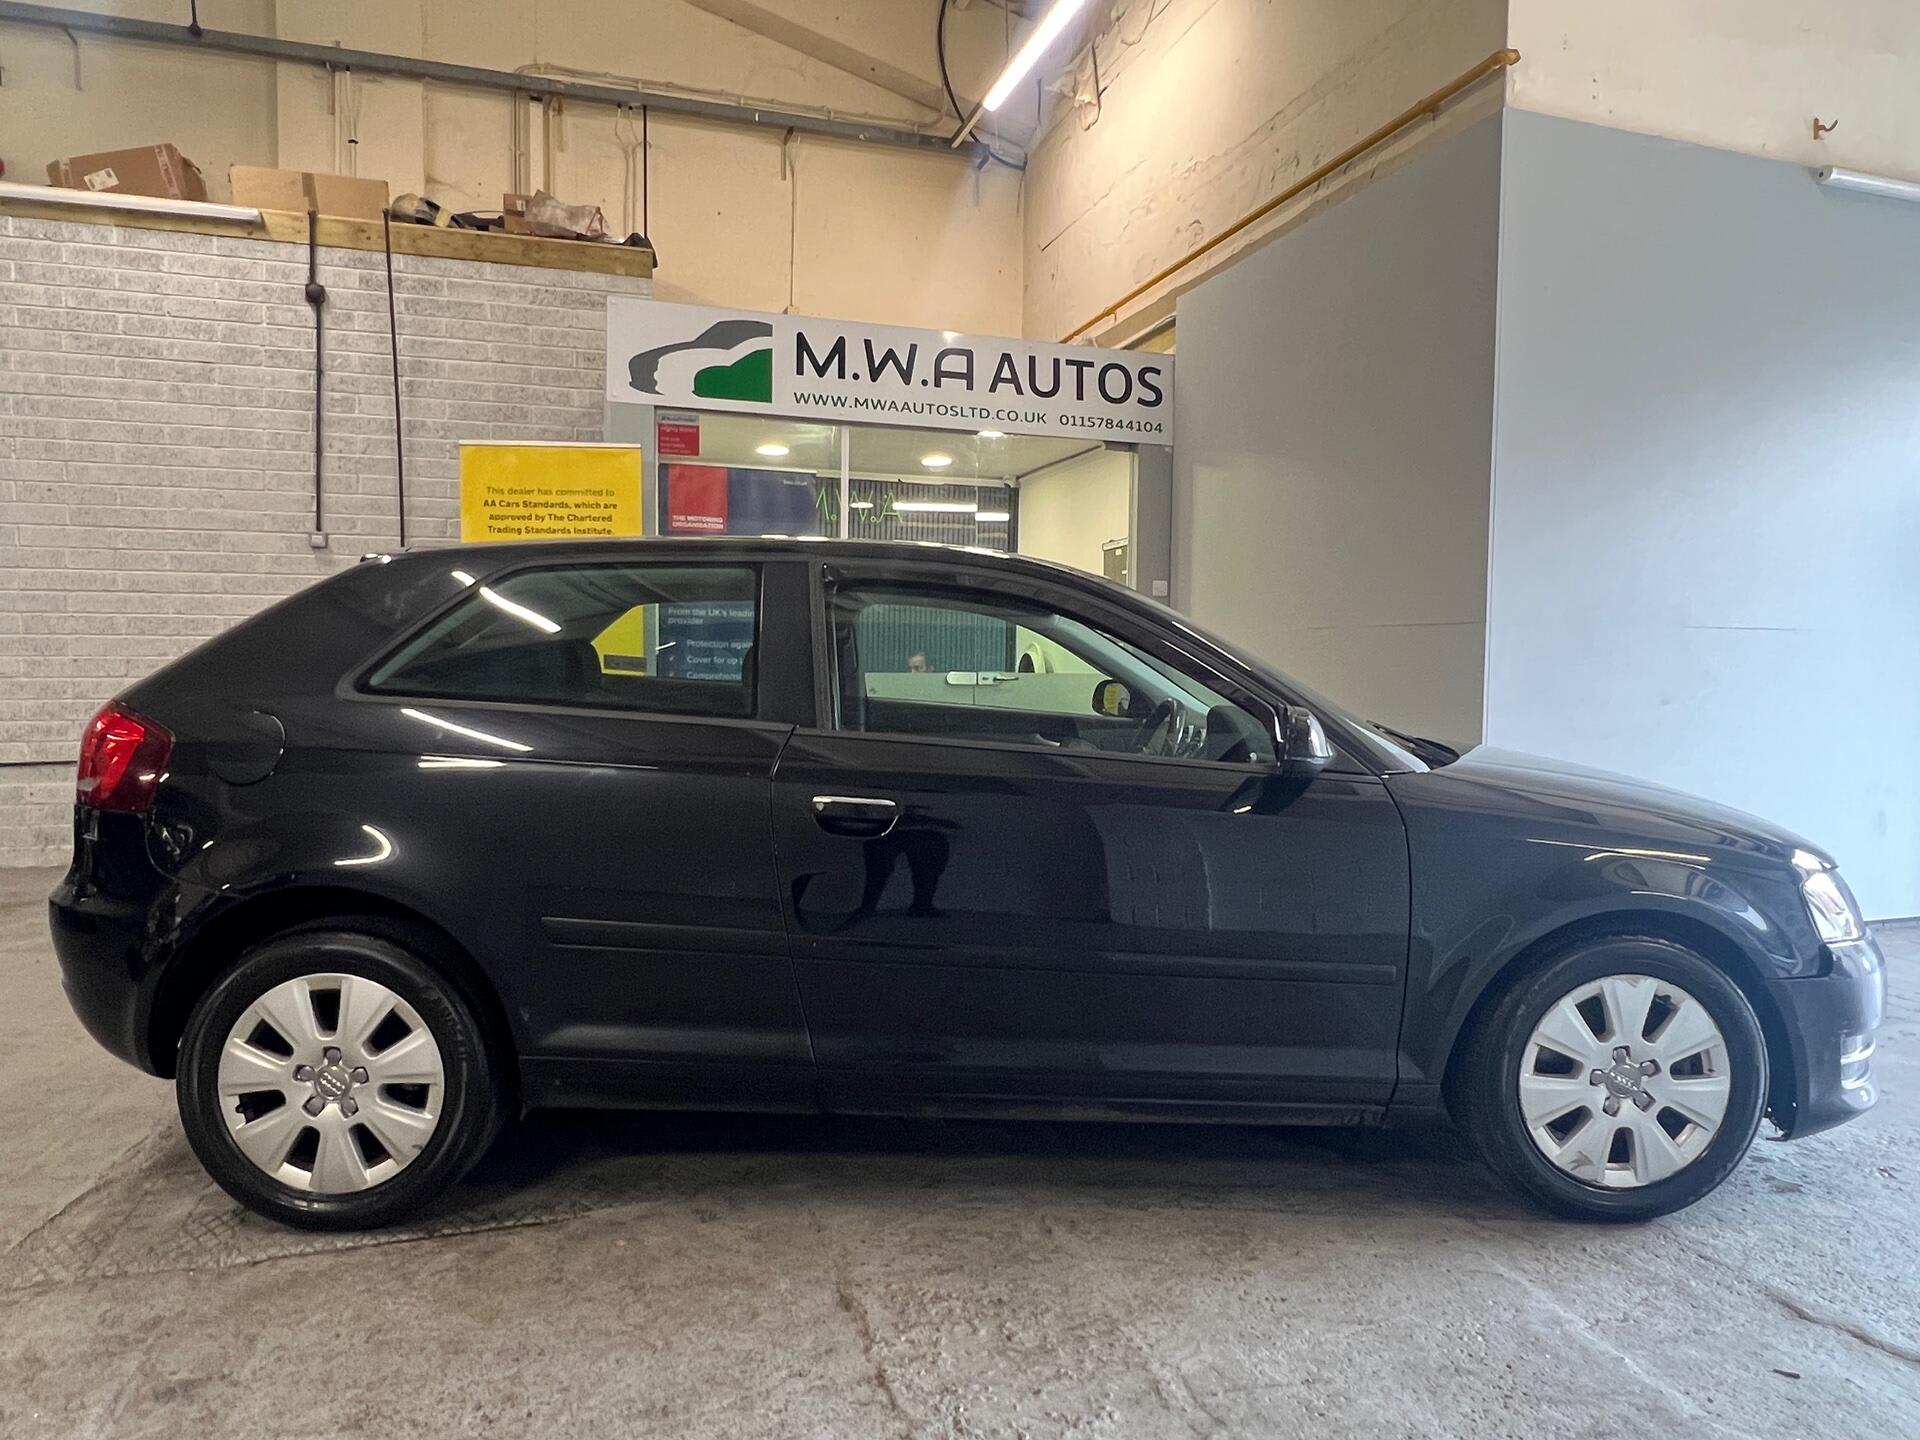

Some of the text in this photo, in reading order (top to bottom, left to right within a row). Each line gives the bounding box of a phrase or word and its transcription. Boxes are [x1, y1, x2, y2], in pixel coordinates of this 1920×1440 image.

[796, 331, 1164, 408] M.W.A AUTOS
[793, 391, 1163, 433] WWW.MWAAUTOSLTD.CO.UK 01157844104
[487, 486, 615, 497] This dealer has committed to
[483, 499, 618, 510] AA Cars Standards, which are
[488, 513, 613, 523] approved by The Chartered
[487, 525, 615, 536] Trading Standards Institute.
[668, 607, 691, 616] From
[692, 608, 706, 617] the
[686, 640, 729, 649] Protection
[686, 655, 711, 664] Cover
[713, 655, 725, 664] for
